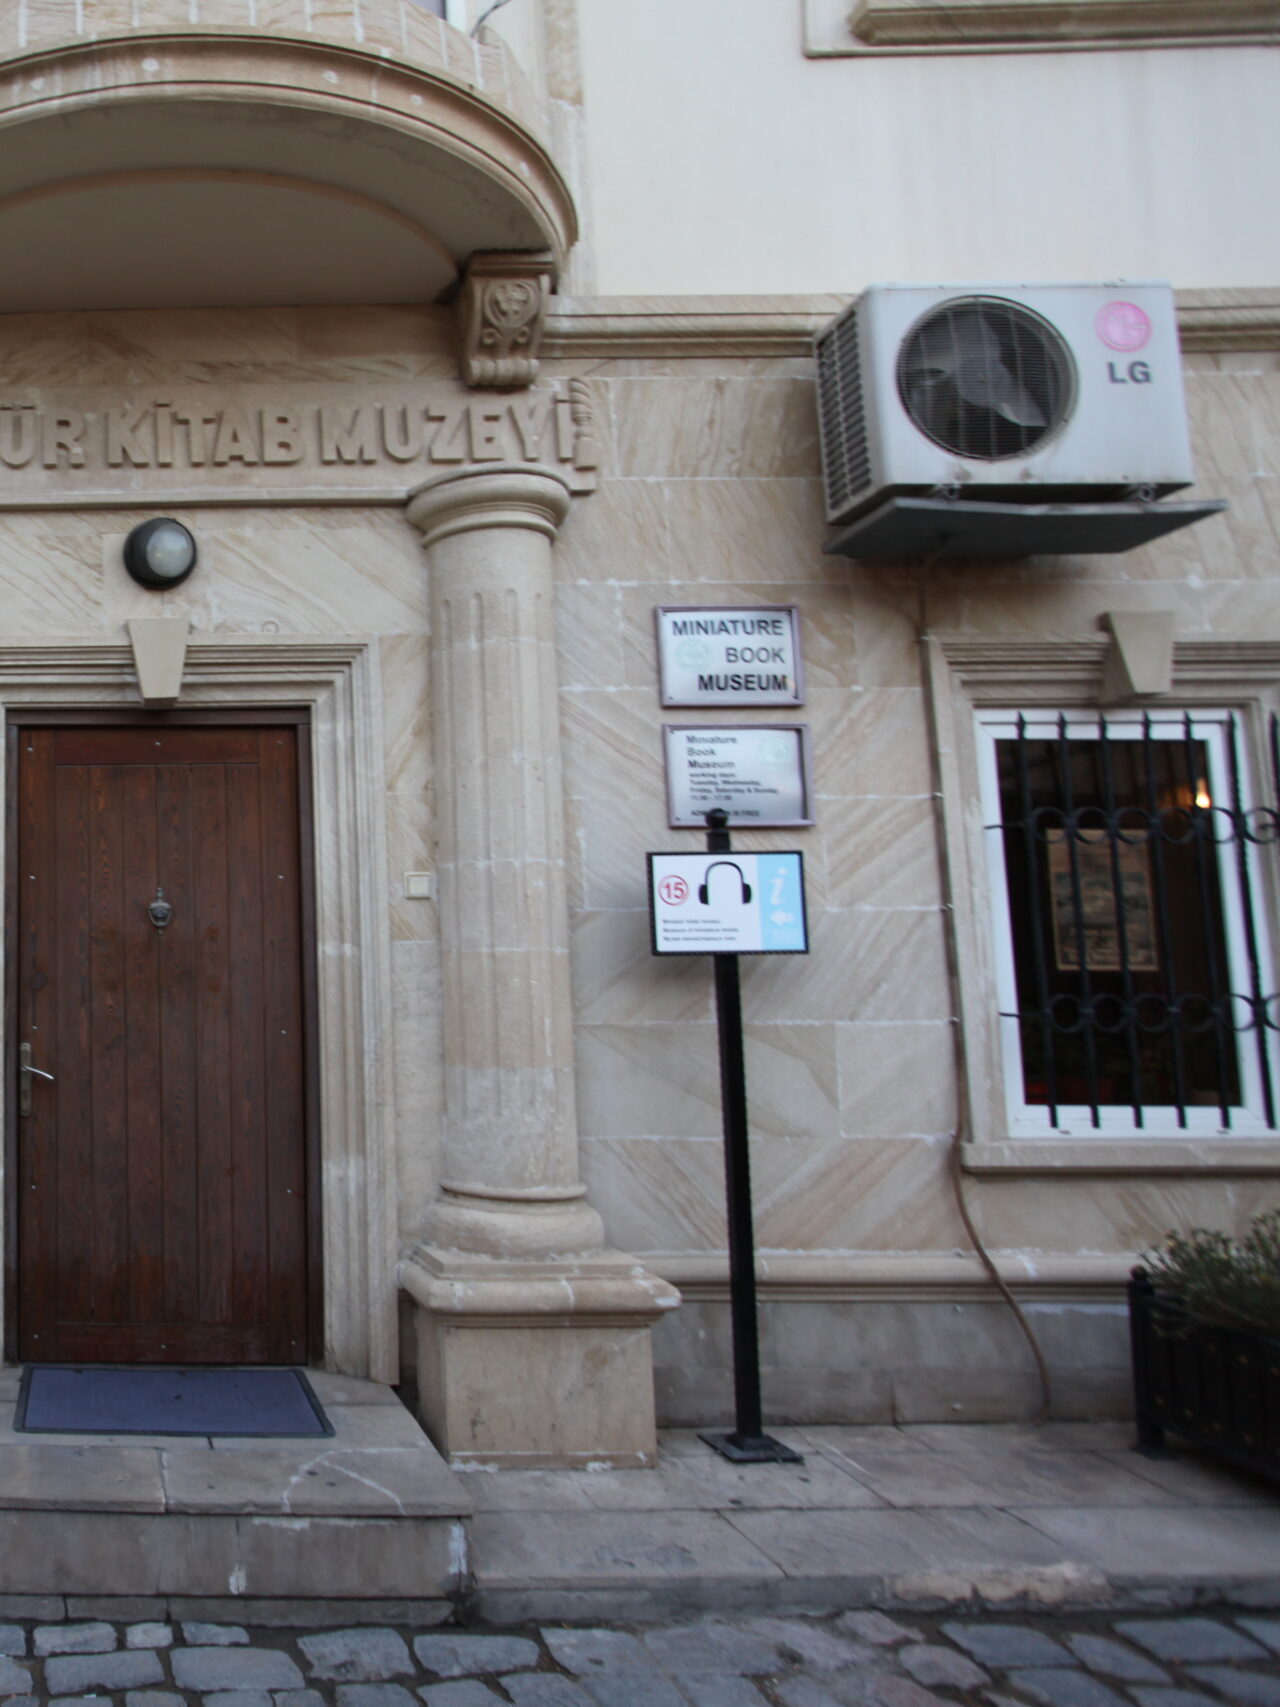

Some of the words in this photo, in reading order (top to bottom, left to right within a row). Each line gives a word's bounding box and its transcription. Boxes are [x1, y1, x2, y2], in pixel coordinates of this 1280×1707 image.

[1106, 360, 1153, 384] LG
[106, 400, 303, 468] KİTAB
[321, 391, 575, 465] MUZEYİ
[671, 619, 785, 637] MINIATURE
[725, 646, 786, 664] BOOK
[698, 674, 788, 692] MUSEUM
[686, 735, 737, 744] Miniature
[687, 747, 716, 756] Book
[688, 760, 735, 769] Museum
[664, 881, 685, 899] 15
